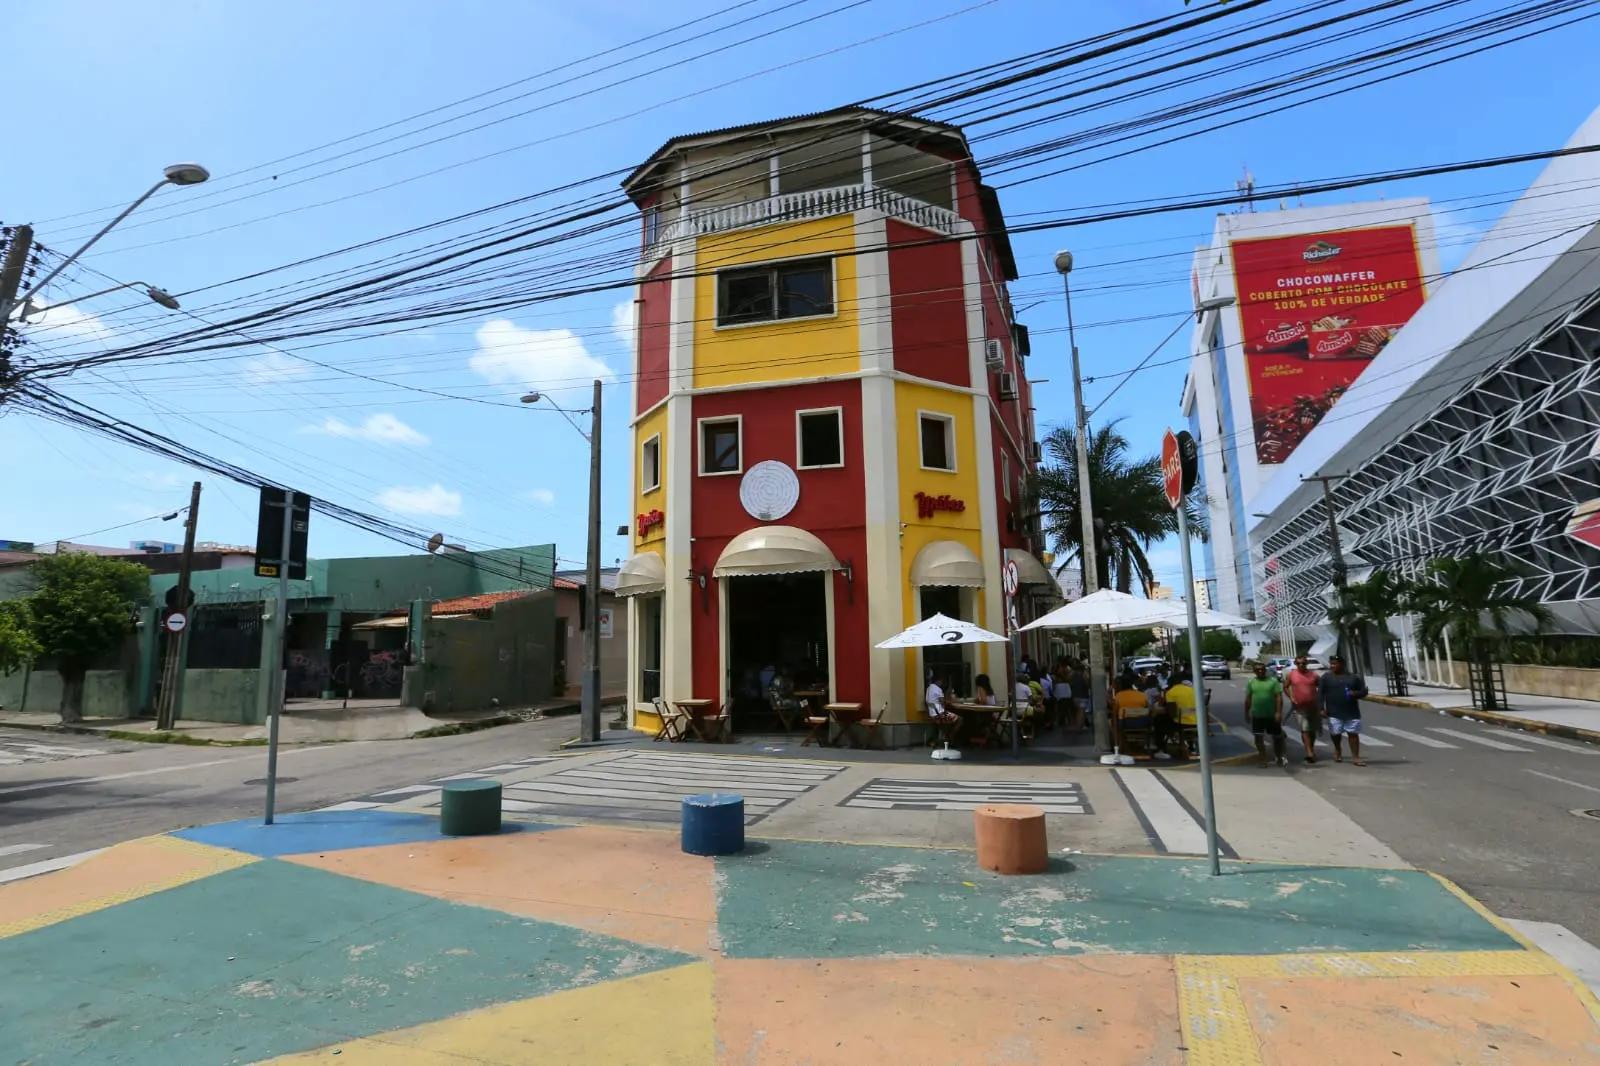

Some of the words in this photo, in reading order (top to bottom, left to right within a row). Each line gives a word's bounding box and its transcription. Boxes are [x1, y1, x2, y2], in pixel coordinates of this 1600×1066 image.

[1277, 271, 1375, 287] CHOCOWAFFER
[1250, 288, 1302, 300] COBERTO
[1307, 286, 1332, 296] COM
[1337, 280, 1408, 294] CHOCOLATE
[1274, 300, 1307, 310] 100%
[1311, 298, 1326, 307] DE
[1332, 293, 1385, 306] VERDADE
[1163, 449, 1181, 485] PARE
